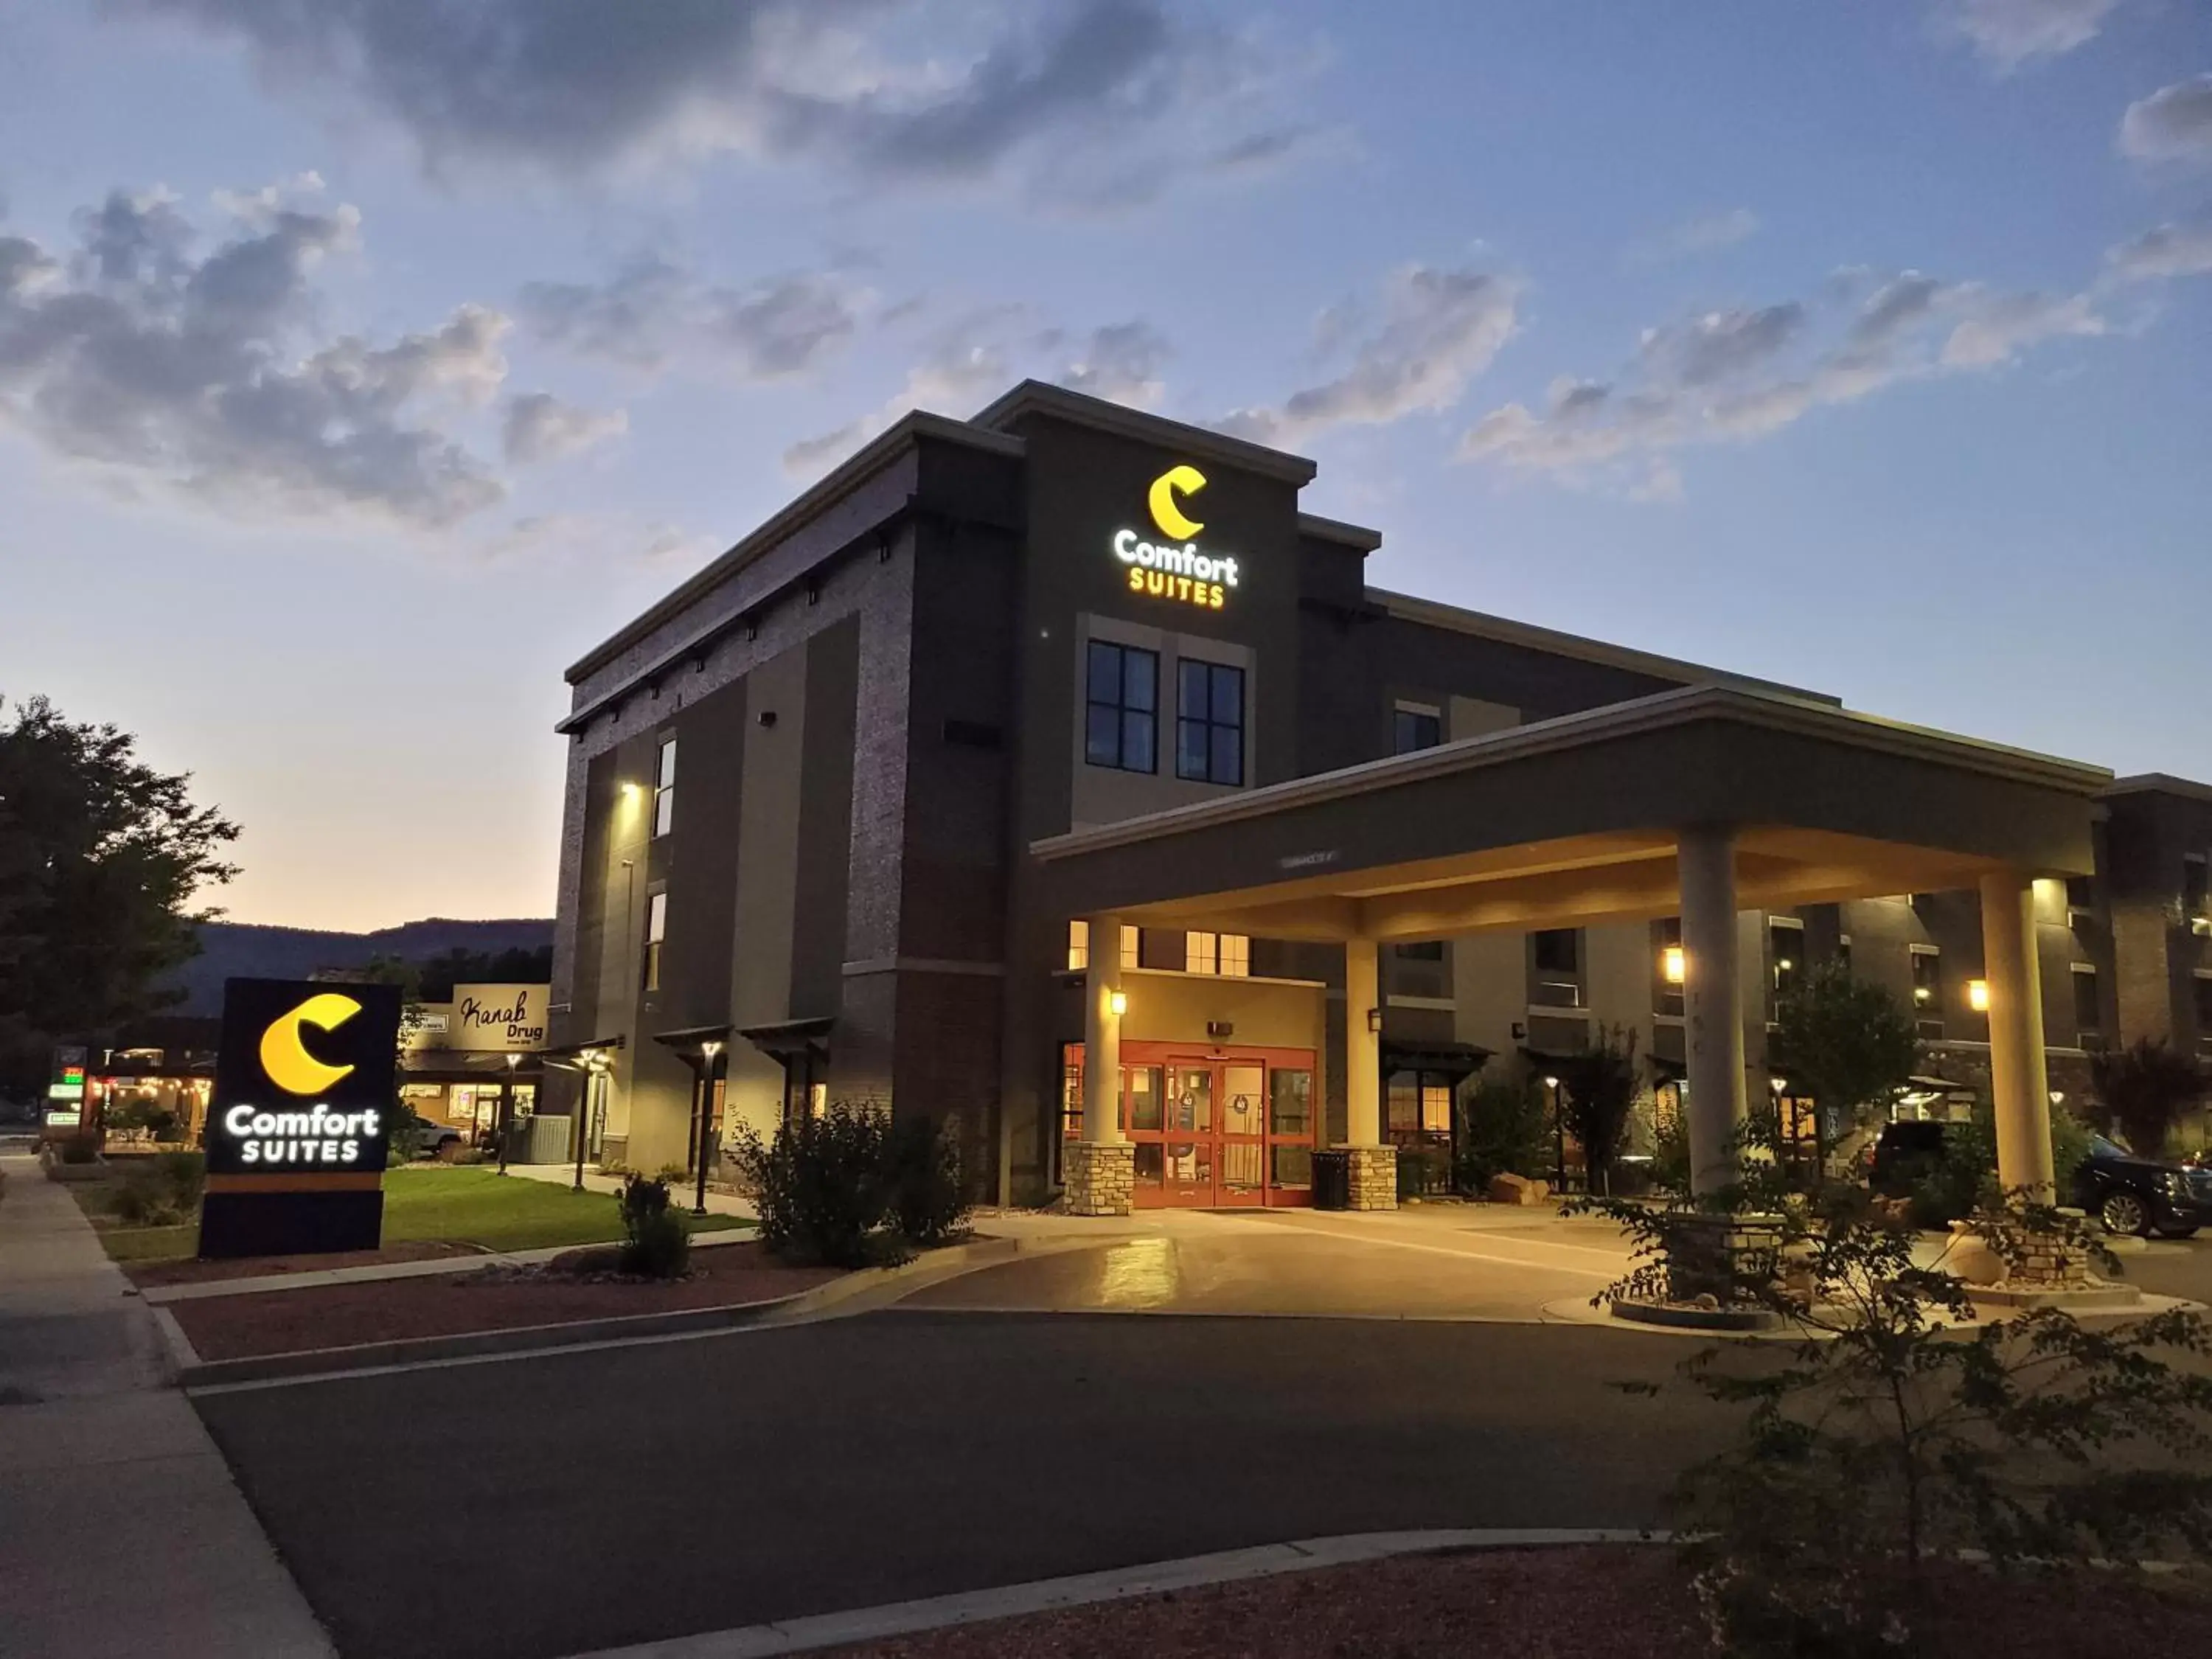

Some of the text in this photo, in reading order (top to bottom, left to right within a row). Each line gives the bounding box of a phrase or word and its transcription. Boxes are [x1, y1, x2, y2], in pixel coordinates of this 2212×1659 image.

[1114, 529, 1238, 586] Comfort
[1129, 566, 1224, 608] SUITES
[460, 990, 527, 1028] Kanab
[507, 1024, 543, 1040] Drug
[226, 1104, 379, 1137] Comfort
[241, 1140, 359, 1163] SUITES
